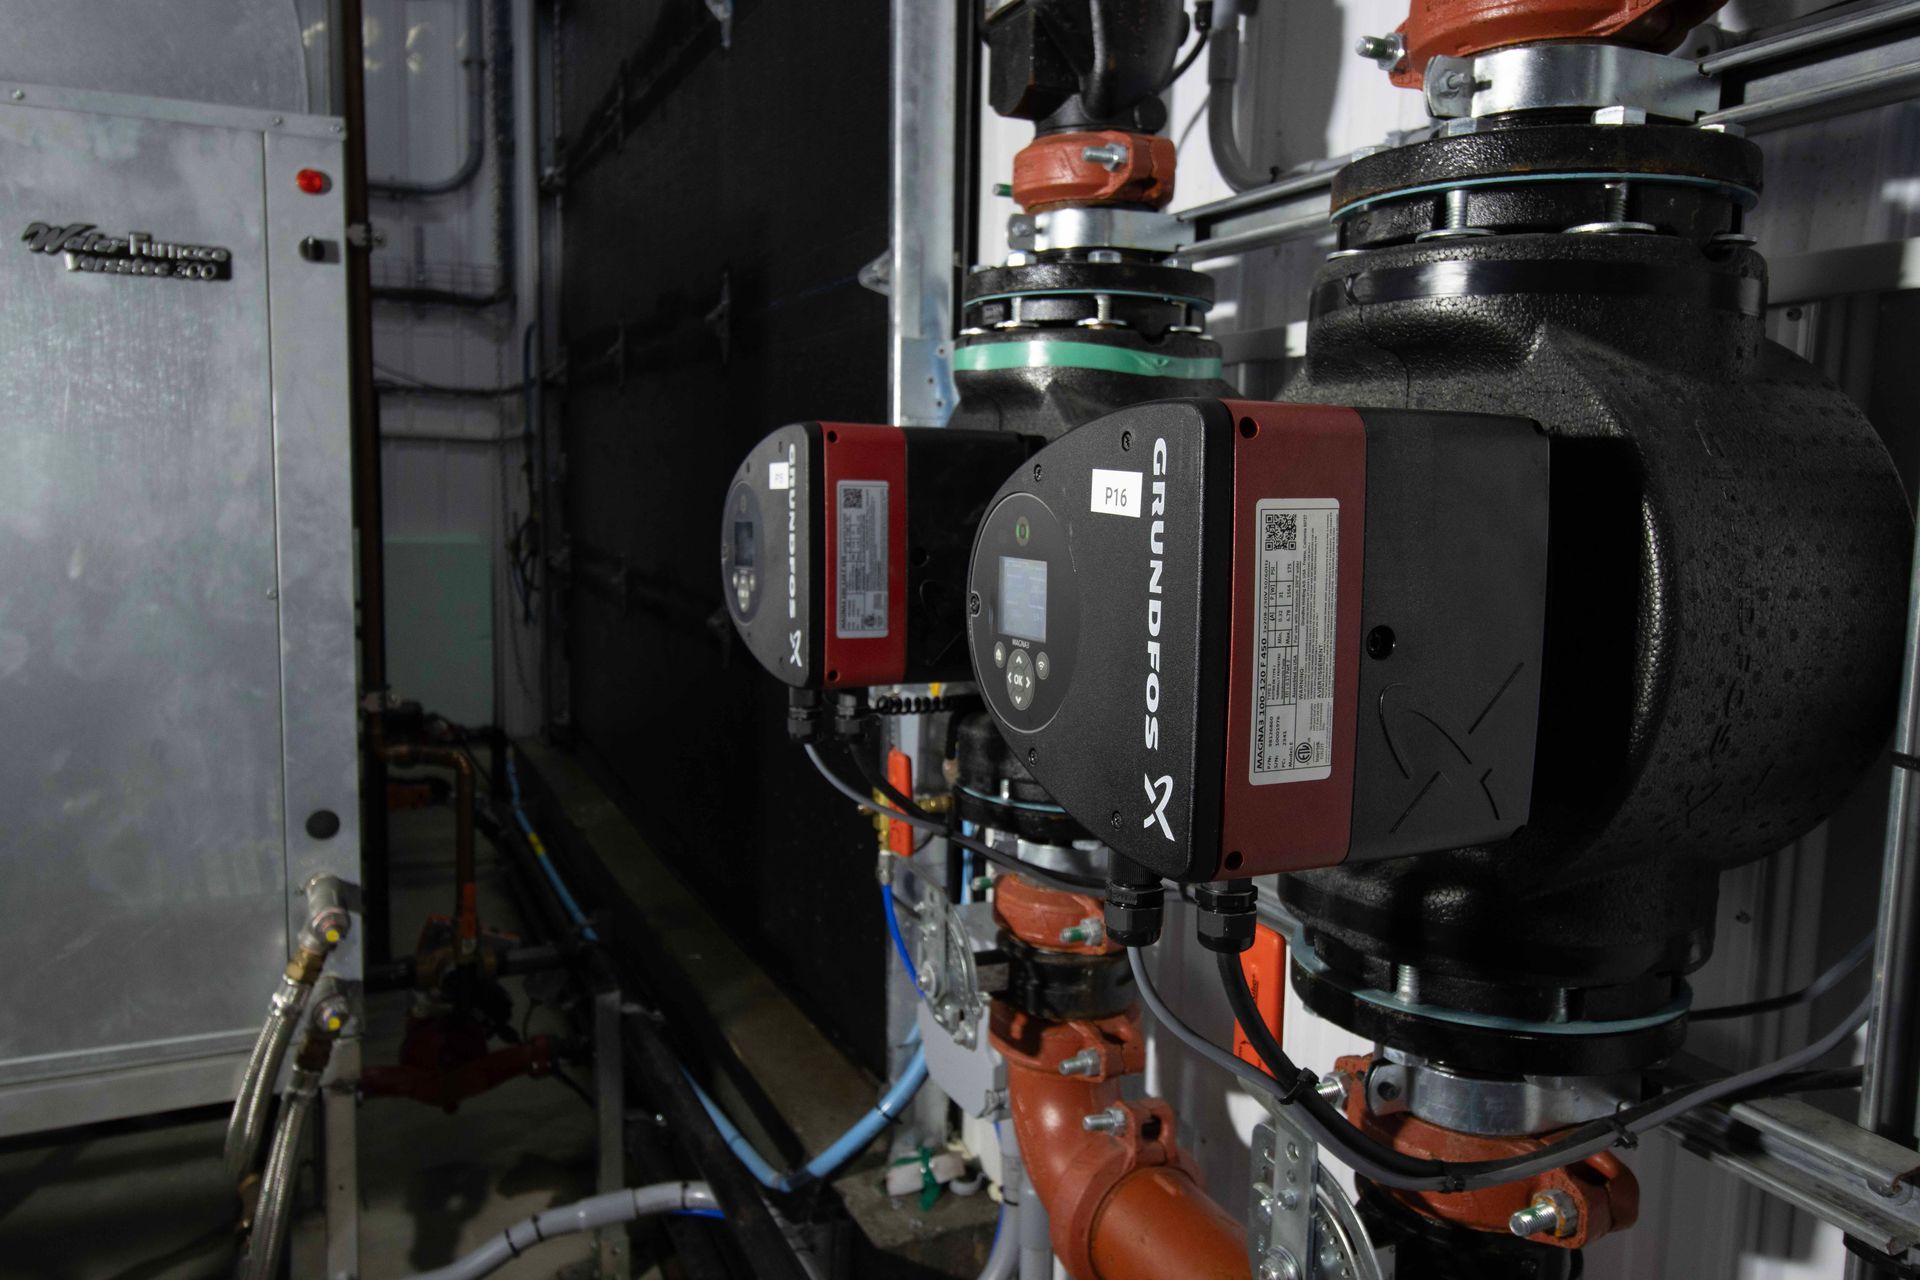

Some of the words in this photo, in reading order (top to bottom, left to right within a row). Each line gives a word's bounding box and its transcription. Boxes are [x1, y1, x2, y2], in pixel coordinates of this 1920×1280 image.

[63, 250, 171, 278] Versatec
[1105, 486, 1128, 508] P16
[788, 442, 797, 619] GRUNDFOS
[1144, 437, 1168, 751] GRUNDFOS
[1012, 639, 1031, 649] MAGNA3
[1260, 638, 1268, 659] 450
[1013, 673, 1025, 687] OK
[1257, 719, 1265, 770] MAGNA3
